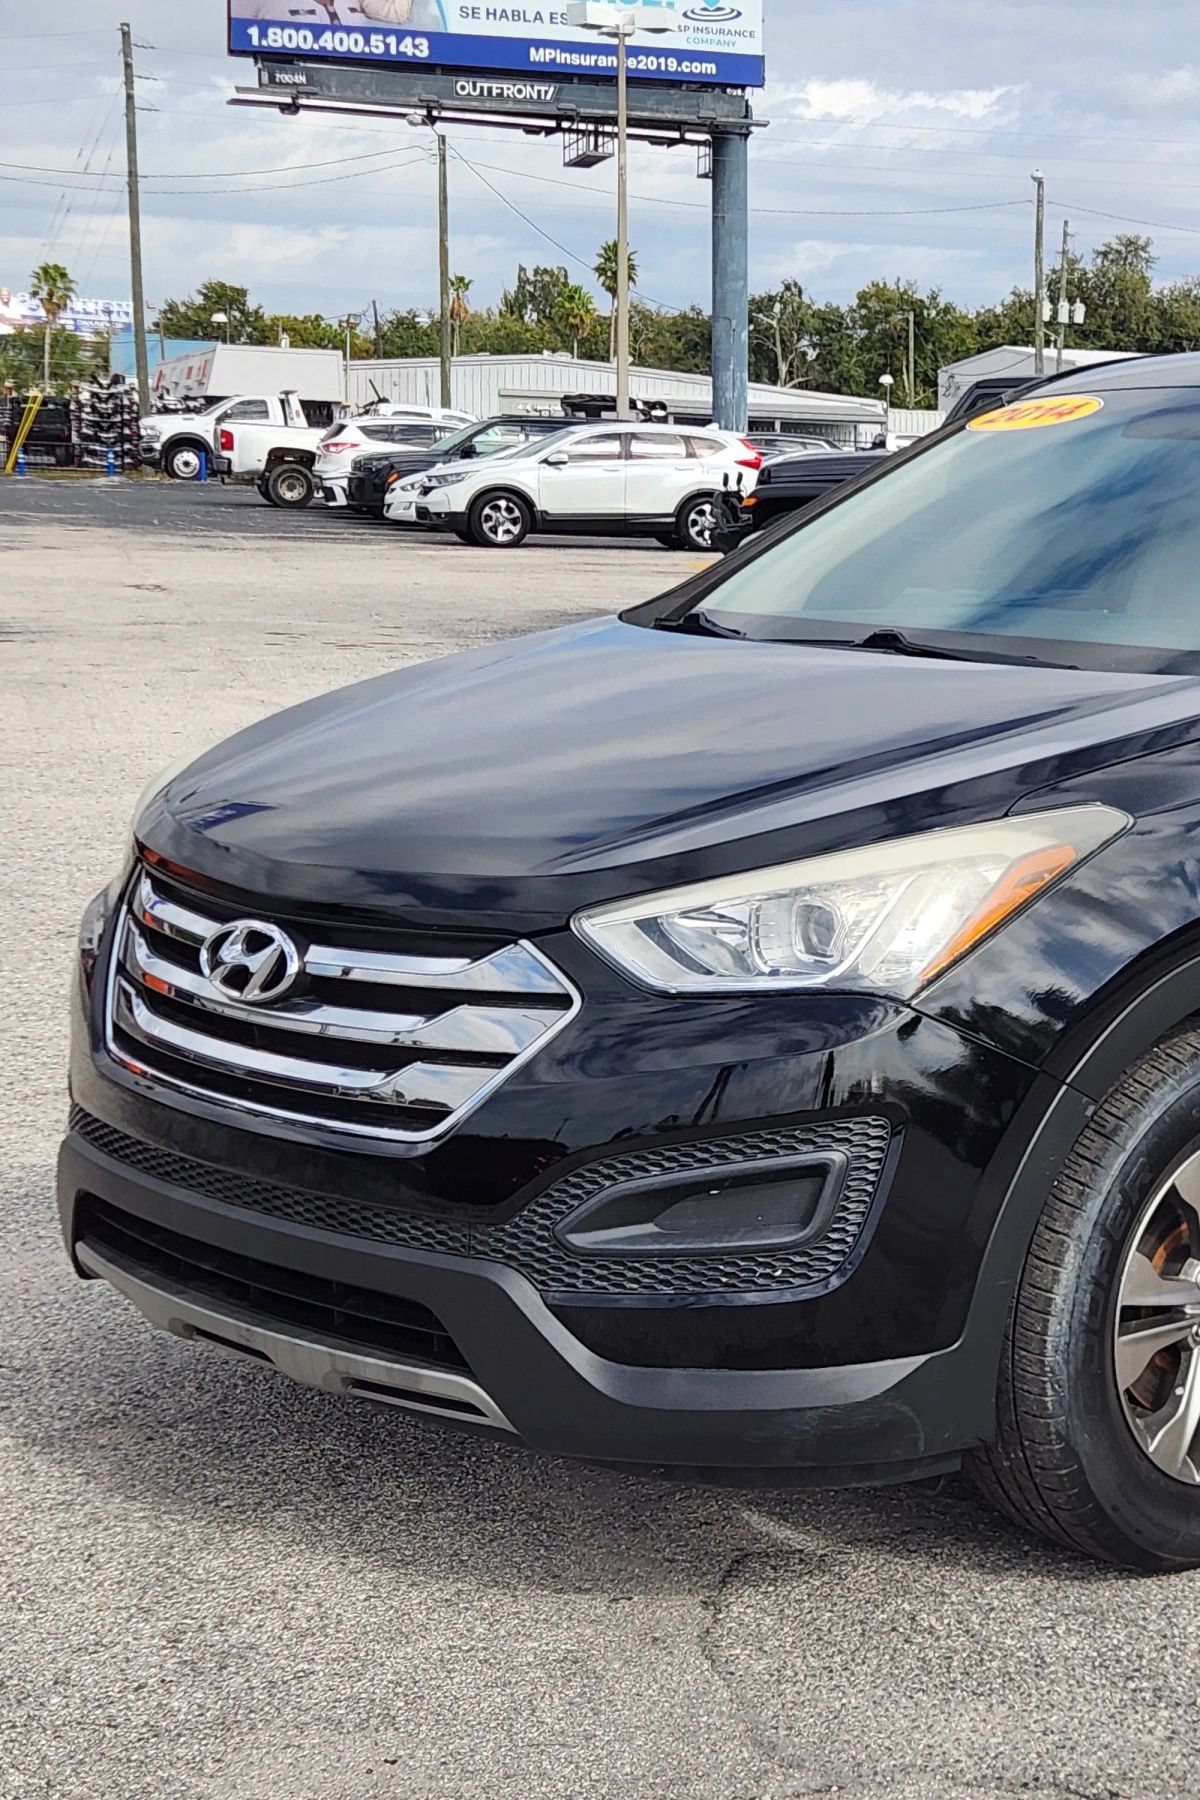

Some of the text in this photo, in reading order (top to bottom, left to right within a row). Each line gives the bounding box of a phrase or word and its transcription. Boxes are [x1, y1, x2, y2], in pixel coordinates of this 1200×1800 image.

[459, 5, 481, 19] SE
[485, 8, 544, 24] HABLA
[247, 25, 430, 58] 1.800.400.5143
[686, 36, 737, 47] COMPANY
[692, 25, 756, 39] INSURANCE
[529, 46, 717, 76] MPInsurane2019.com
[976, 401, 1093, 428] 2014
